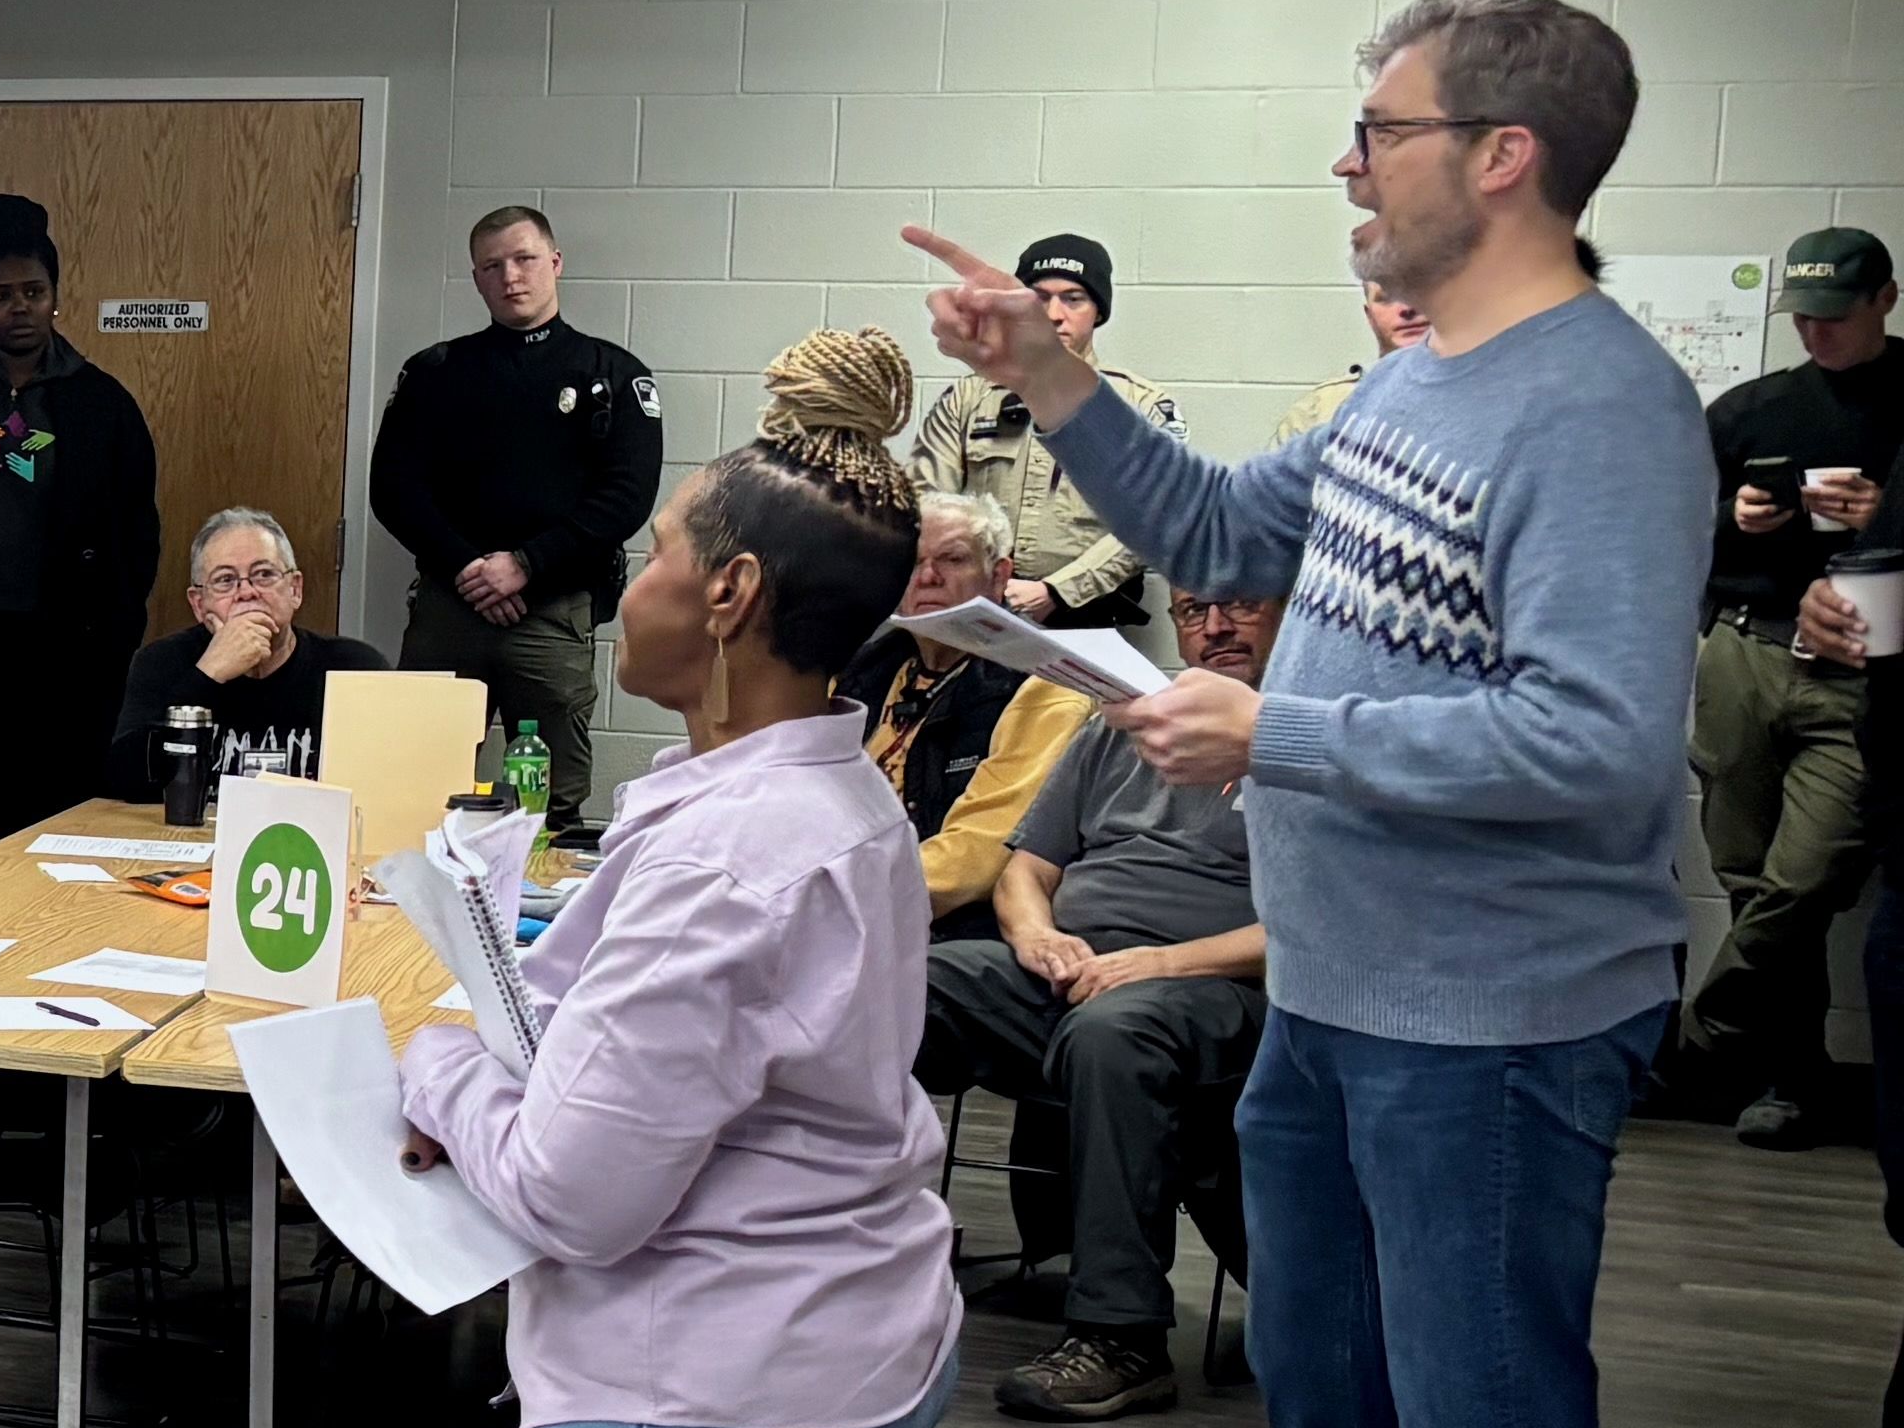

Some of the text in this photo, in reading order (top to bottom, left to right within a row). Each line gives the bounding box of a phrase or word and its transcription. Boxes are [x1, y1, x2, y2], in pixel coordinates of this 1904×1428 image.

[1033, 257, 1085, 275] RANGER
[118, 303, 190, 316] AUTHORIZED
[103, 317, 203, 329] PERSONNEL ONLY
[249, 861, 318, 935] 24
